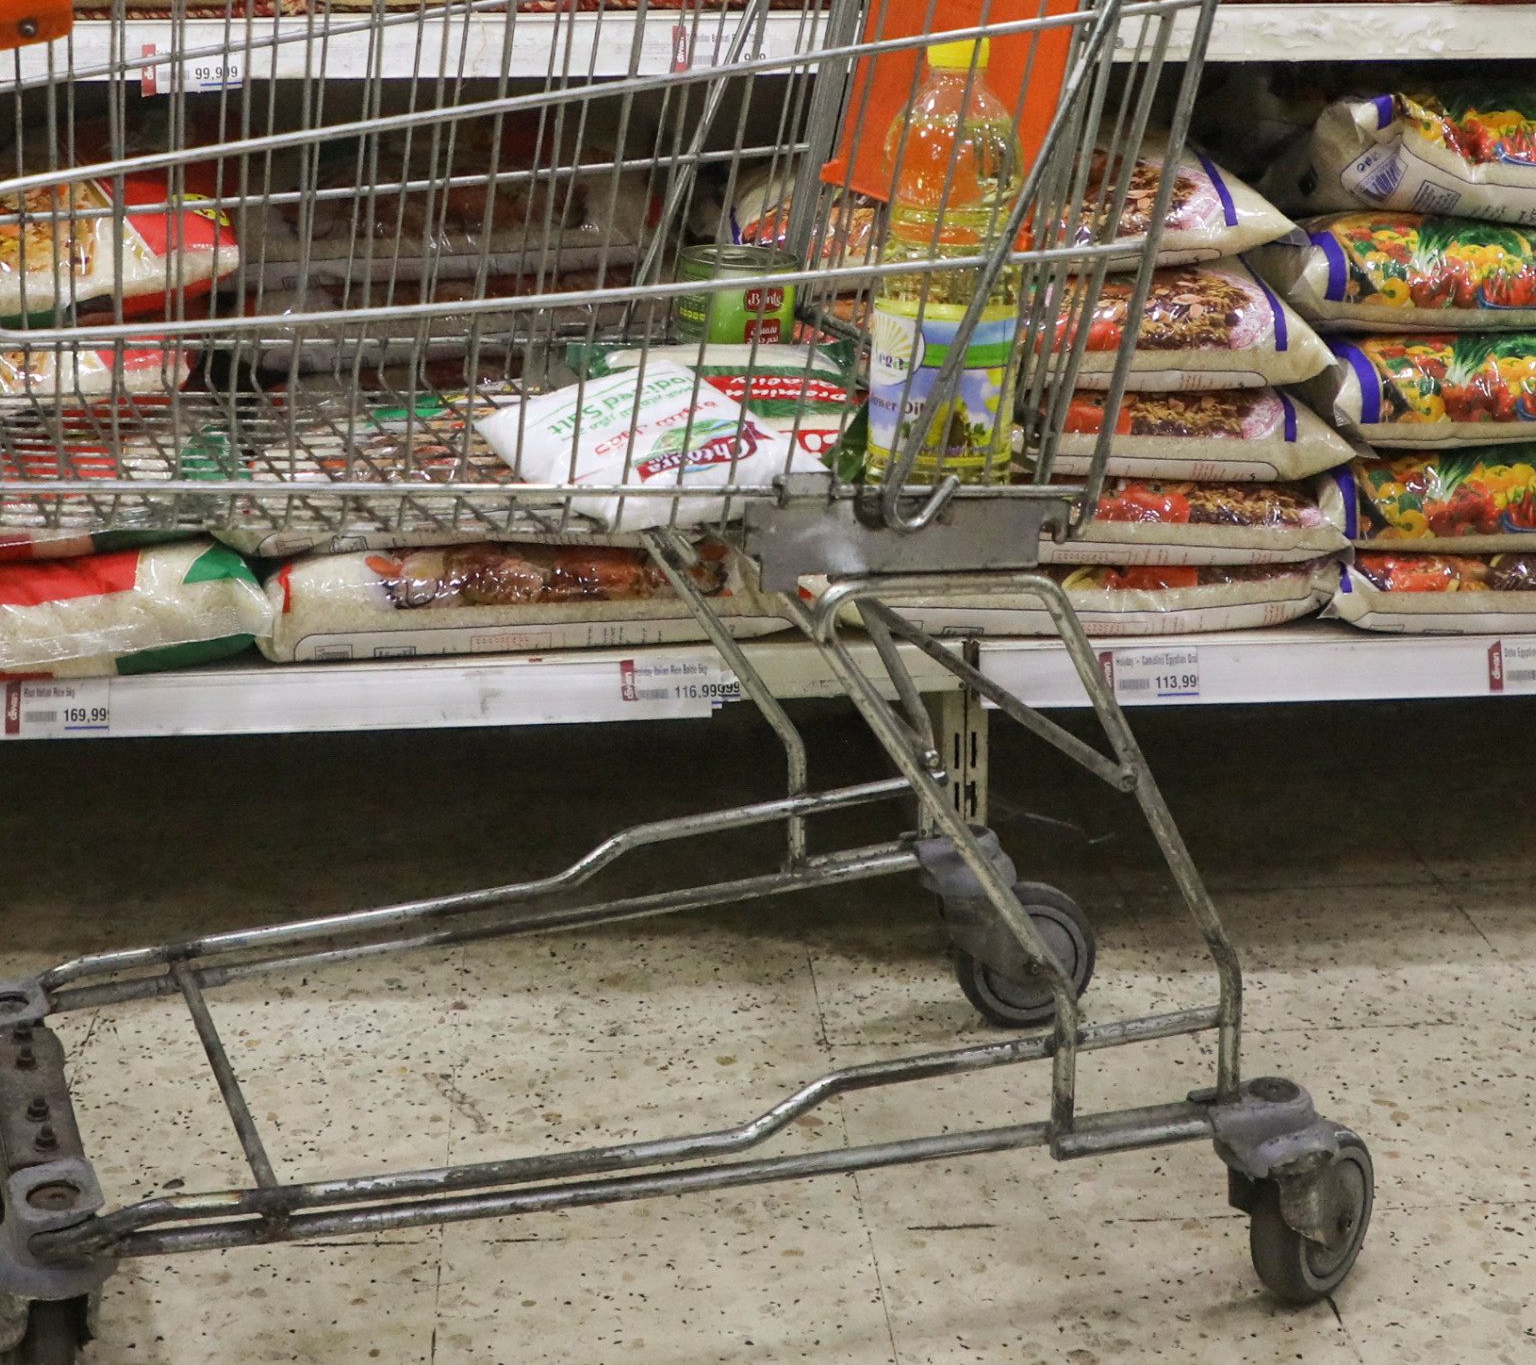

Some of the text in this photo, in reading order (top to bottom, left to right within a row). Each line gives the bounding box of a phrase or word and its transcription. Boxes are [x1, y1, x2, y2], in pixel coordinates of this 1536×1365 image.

[195, 66, 238, 81] 99,99
[603, 376, 696, 411] Iodied
[647, 437, 750, 472] Chtoura
[670, 664, 682, 675] Rice
[53, 687, 65, 697] Rice
[8, 692, 19, 721] diwan
